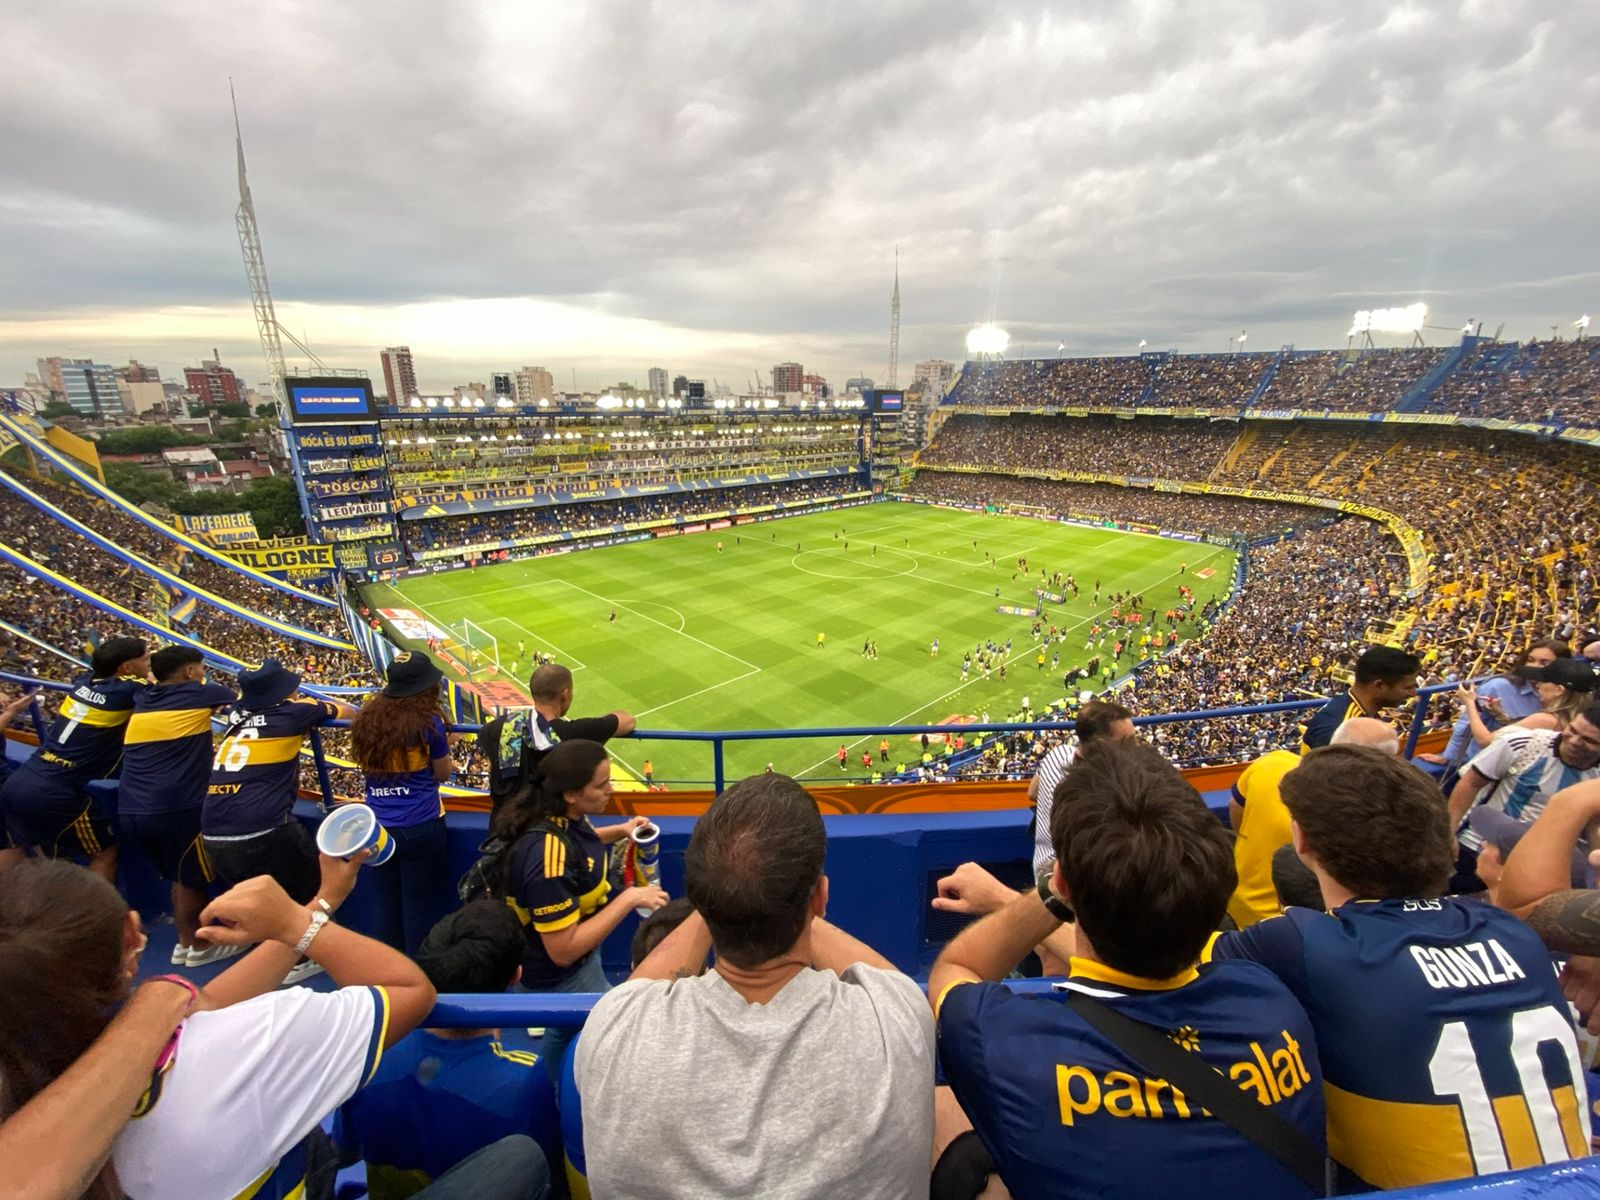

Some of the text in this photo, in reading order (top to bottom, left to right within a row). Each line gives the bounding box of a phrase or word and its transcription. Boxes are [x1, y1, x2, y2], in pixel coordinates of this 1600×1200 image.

[301, 436, 324, 448] BOCA
[325, 436, 335, 447] ES
[336, 436, 348, 446] SU
[349, 434, 374, 446] GENTE
[610, 443, 649, 451] BOCA
[656, 441, 711, 449] CONTRA
[321, 480, 378, 493] TOSCAS
[416, 491, 465, 505] BOCA
[473, 487, 526, 500] UNICO
[534, 482, 589, 495] BARRIO
[621, 474, 678, 488] PRIMERA
[1208, 486, 1247, 495] SIEMPRE
[1250, 490, 1276, 498] BOCA
[327, 504, 382, 518] LEOPARDI
[183, 513, 253, 531] LAFERRERE
[216, 532, 257, 543] TABLADA
[58, 701, 90, 745] 7
[1409, 938, 1526, 989] GONZA
[1428, 1005, 1593, 1176] 10
